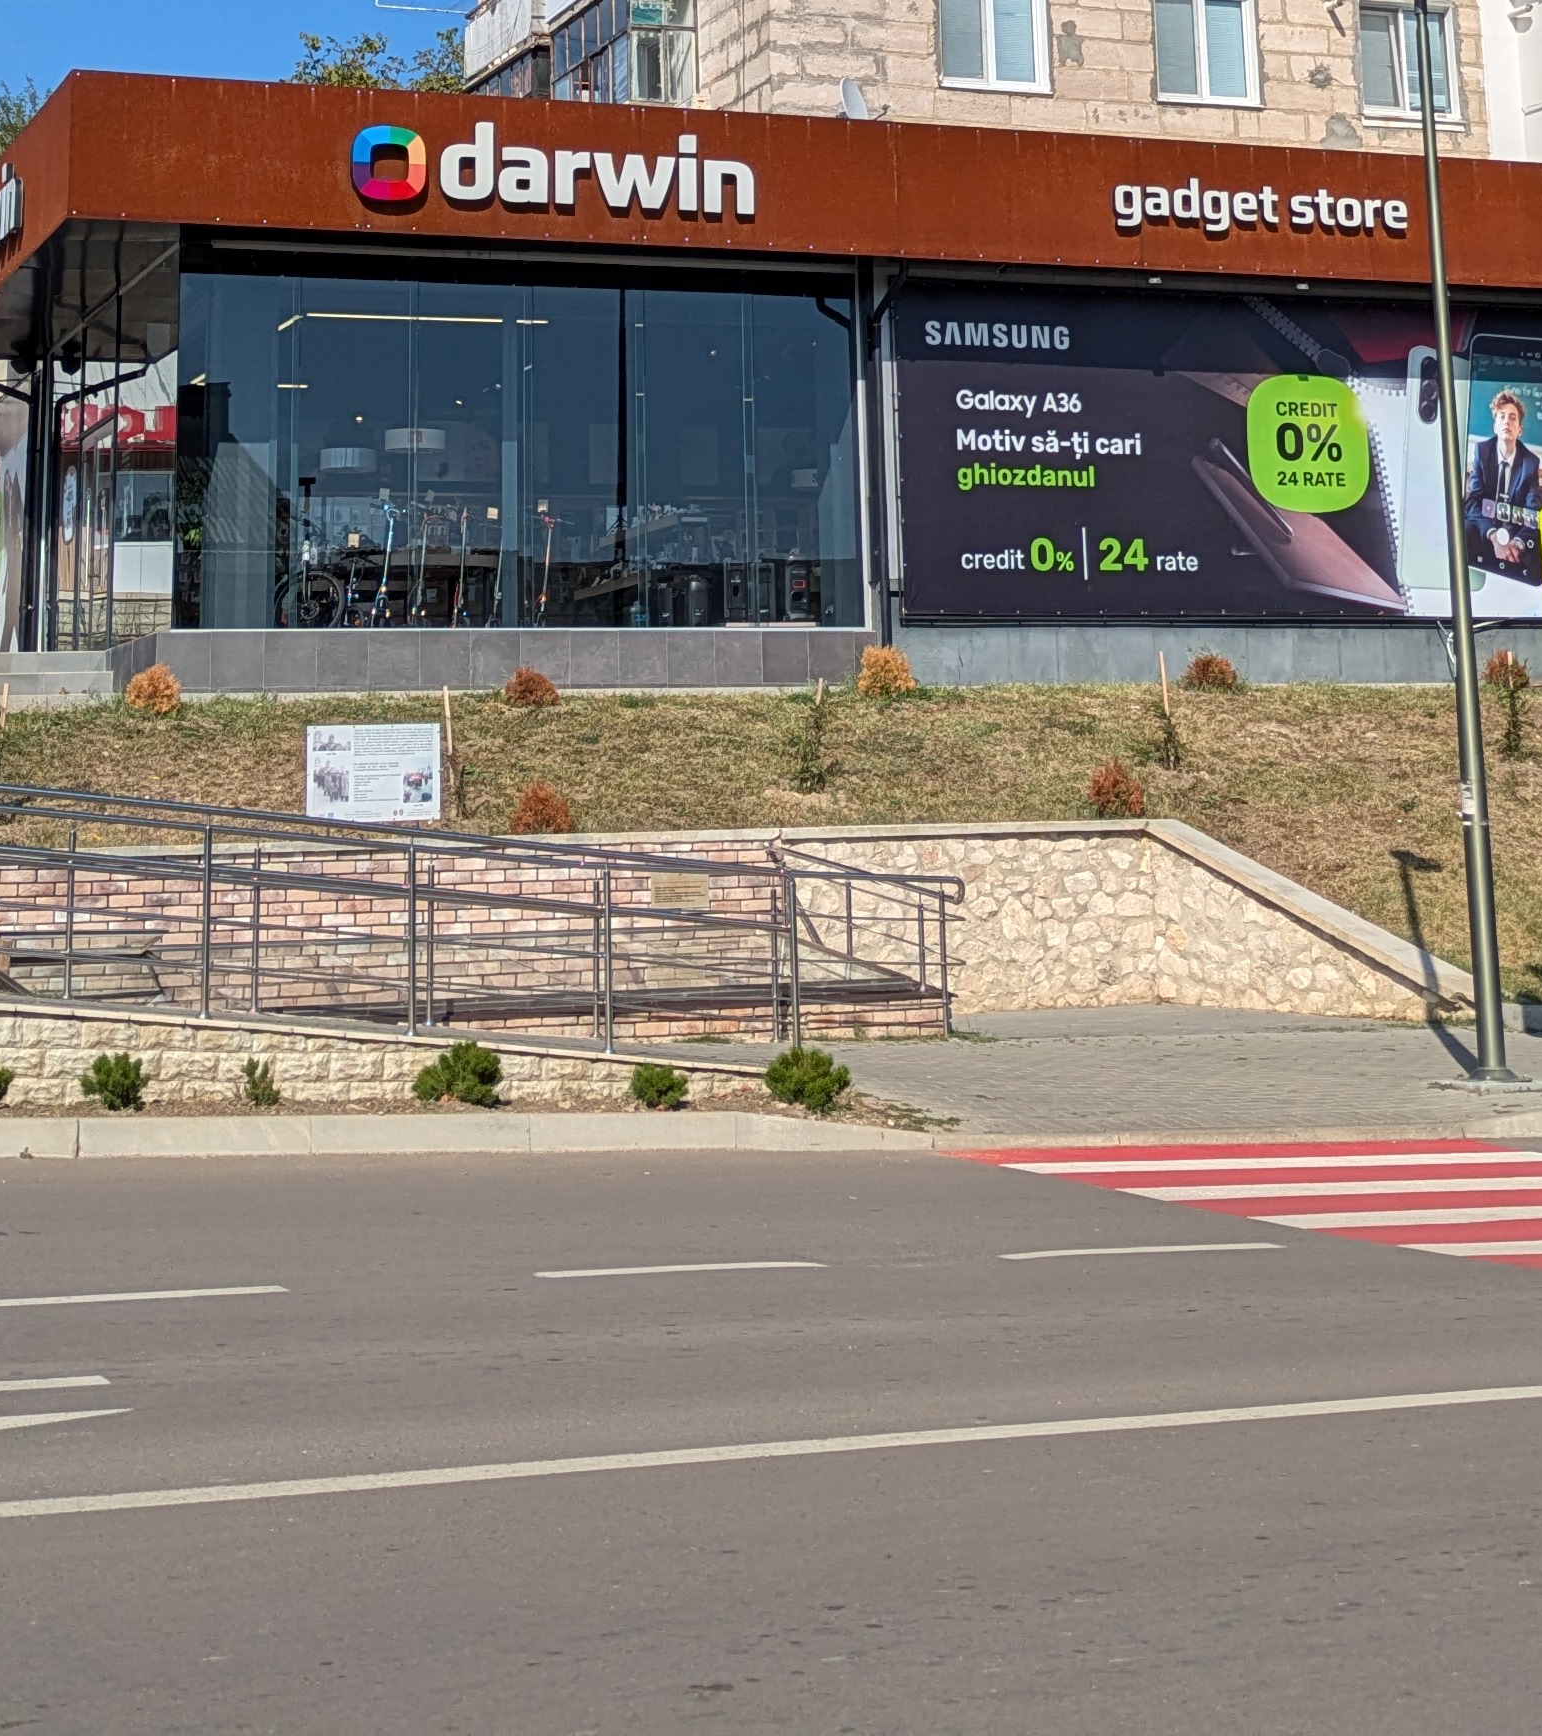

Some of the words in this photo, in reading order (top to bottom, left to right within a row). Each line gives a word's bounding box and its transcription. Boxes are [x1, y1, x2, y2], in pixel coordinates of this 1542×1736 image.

[439, 121, 755, 215] darwin
[1114, 177, 1279, 231] gadget
[1290, 189, 1408, 229] store
[924, 320, 1070, 350] SAMSUNG
[956, 389, 1037, 418] Galaxy
[1042, 392, 1082, 413] A36
[1275, 401, 1337, 417] CREDIT
[956, 429, 1026, 452] Motiv
[1031, 430, 1090, 460] să-ți
[1095, 433, 1141, 455] cari
[1276, 422, 1342, 462] 0%
[957, 462, 1095, 490] ghiozdanul
[1277, 471, 1299, 486] 24
[1303, 471, 1346, 487] RATE
[961, 548, 1026, 570] credit
[1030, 537, 1075, 572] 0%
[1098, 537, 1149, 572] 24
[1156, 551, 1199, 571] rate
